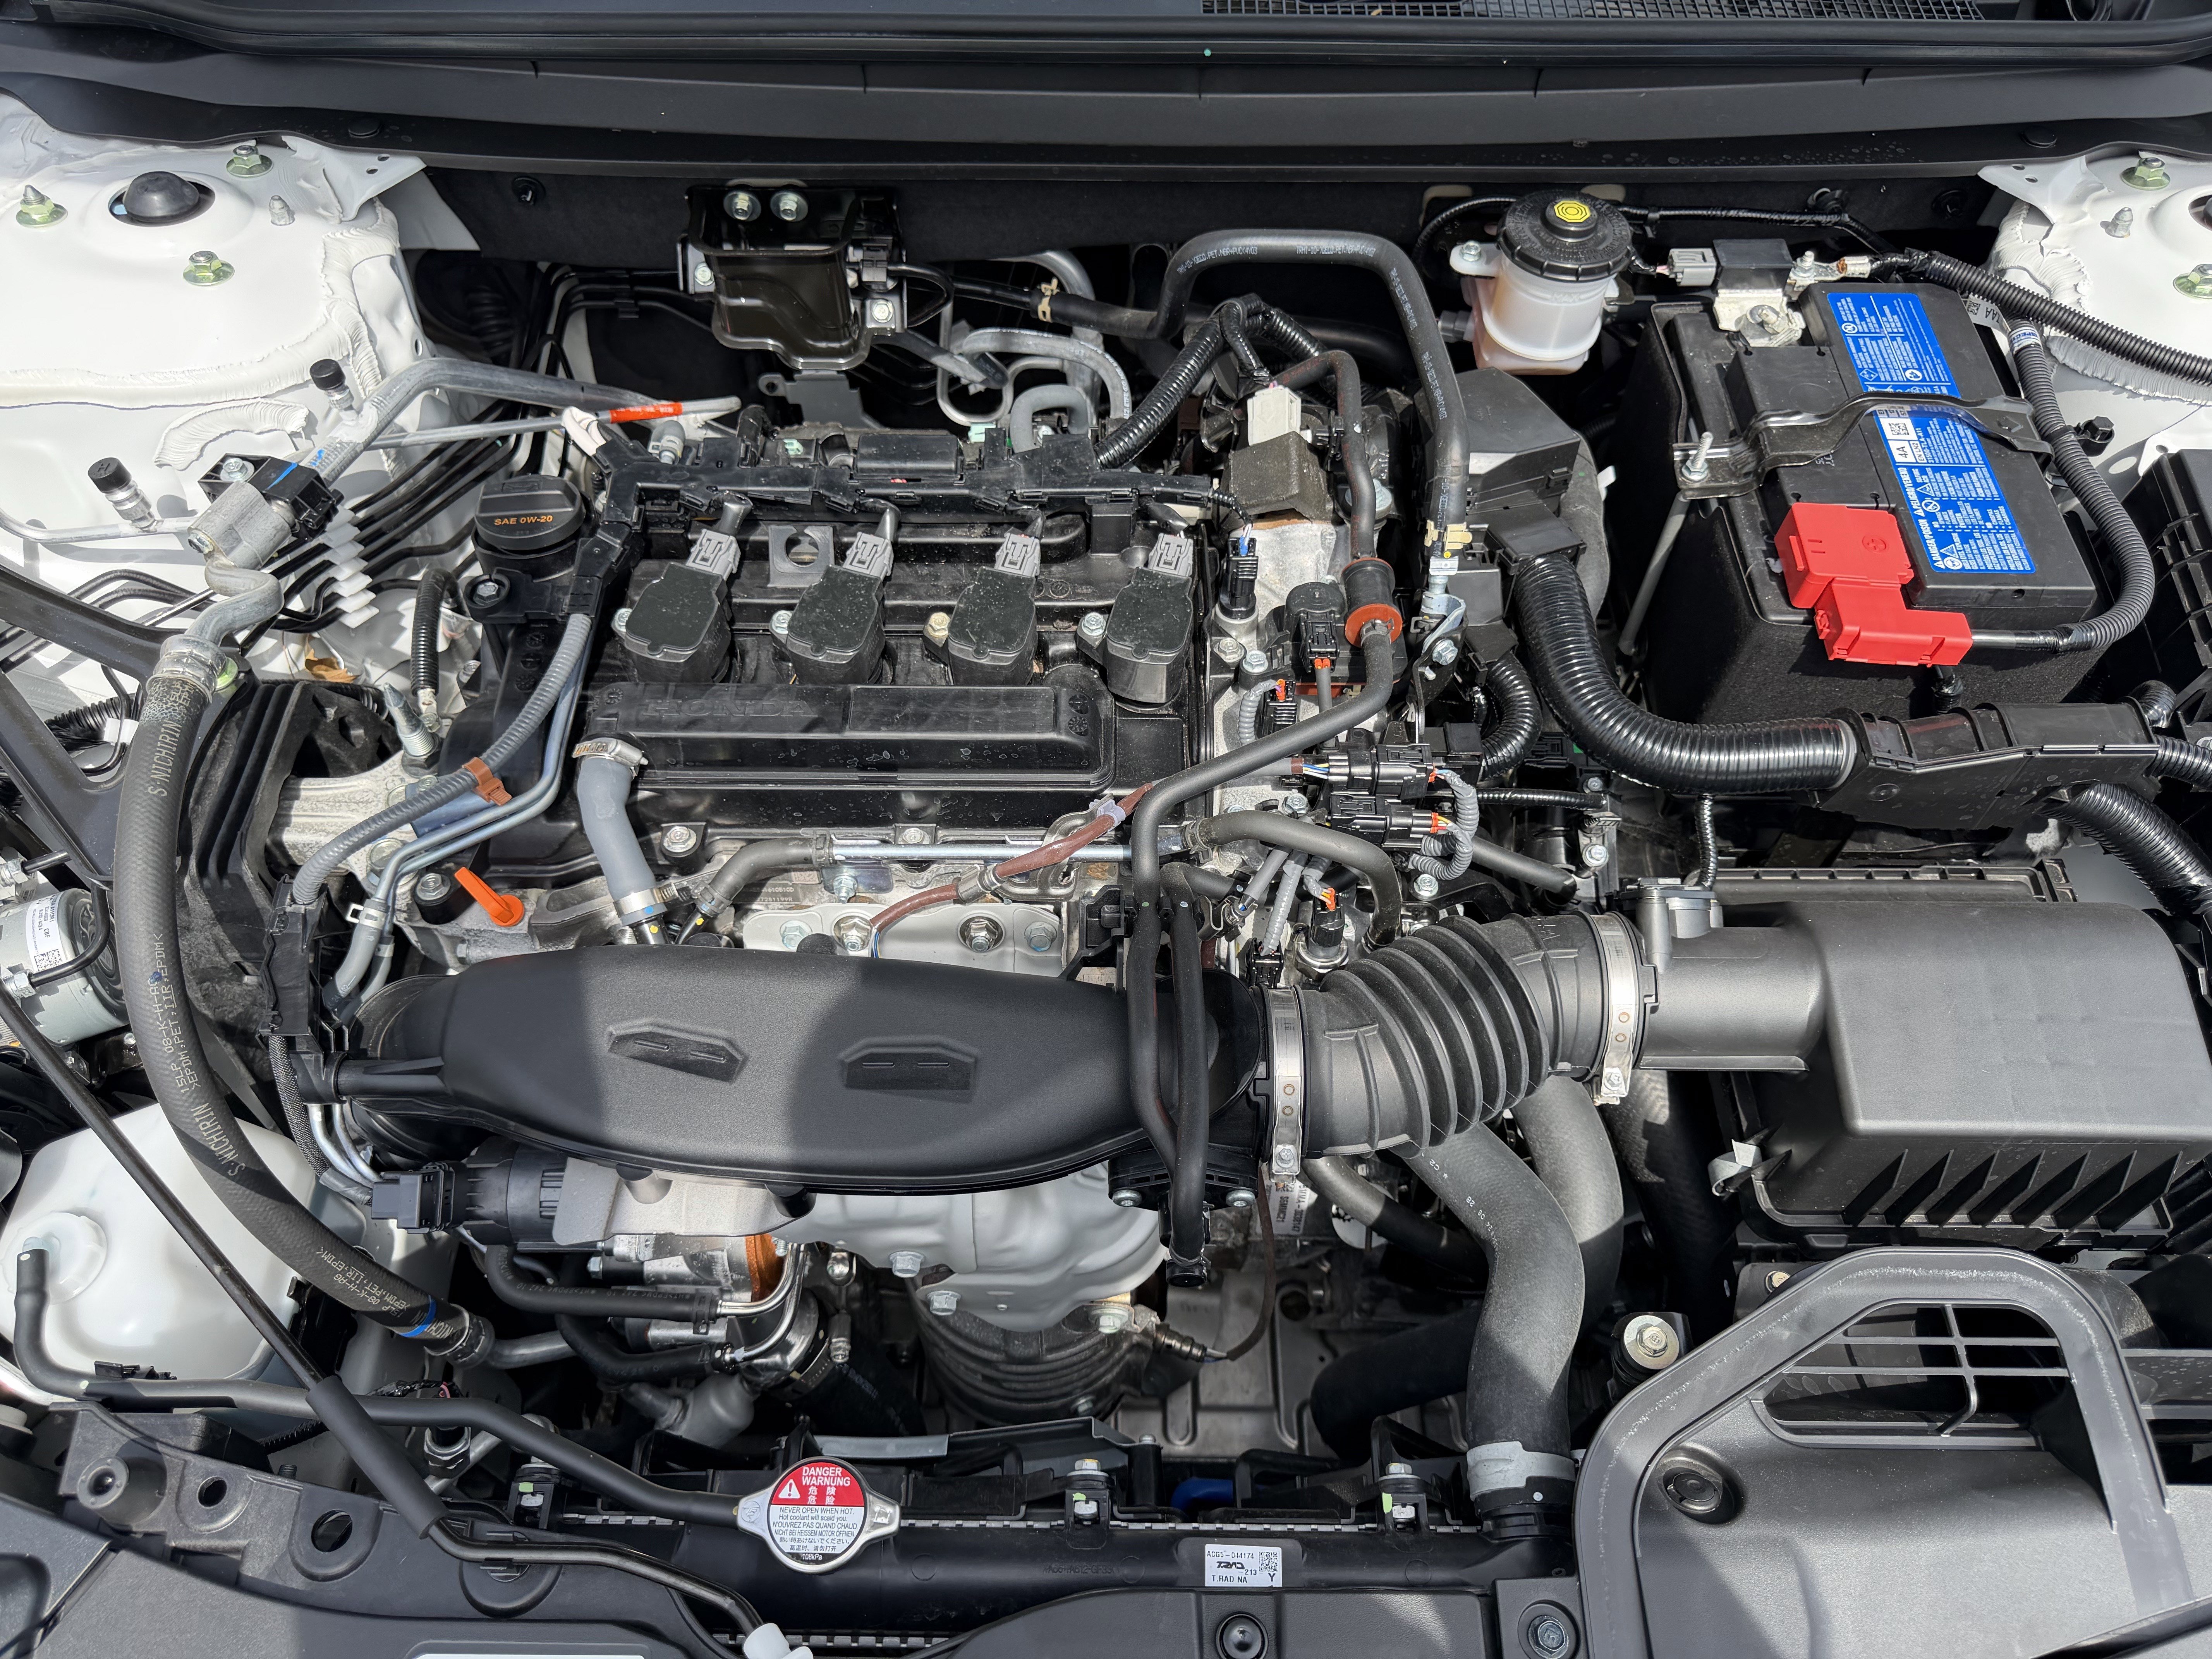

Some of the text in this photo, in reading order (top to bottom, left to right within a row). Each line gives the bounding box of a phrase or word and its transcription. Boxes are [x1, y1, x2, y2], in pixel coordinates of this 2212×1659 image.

[1895, 446, 1910, 458] 4A
[1911, 442, 1921, 452] LN2
[1898, 468, 1920, 508] PELIGRO/VENENO
[520, 515, 553, 524] 0W-20
[1918, 519, 1939, 560] DANGER/POISON
[642, 698, 819, 717] HONDA
[333, 1273, 380, 1305] 08-K-H-AG
[802, 1467, 842, 1476] DANGER
[802, 1476, 850, 1486] WARNUNG
[1268, 1573, 1276, 1582] Y
